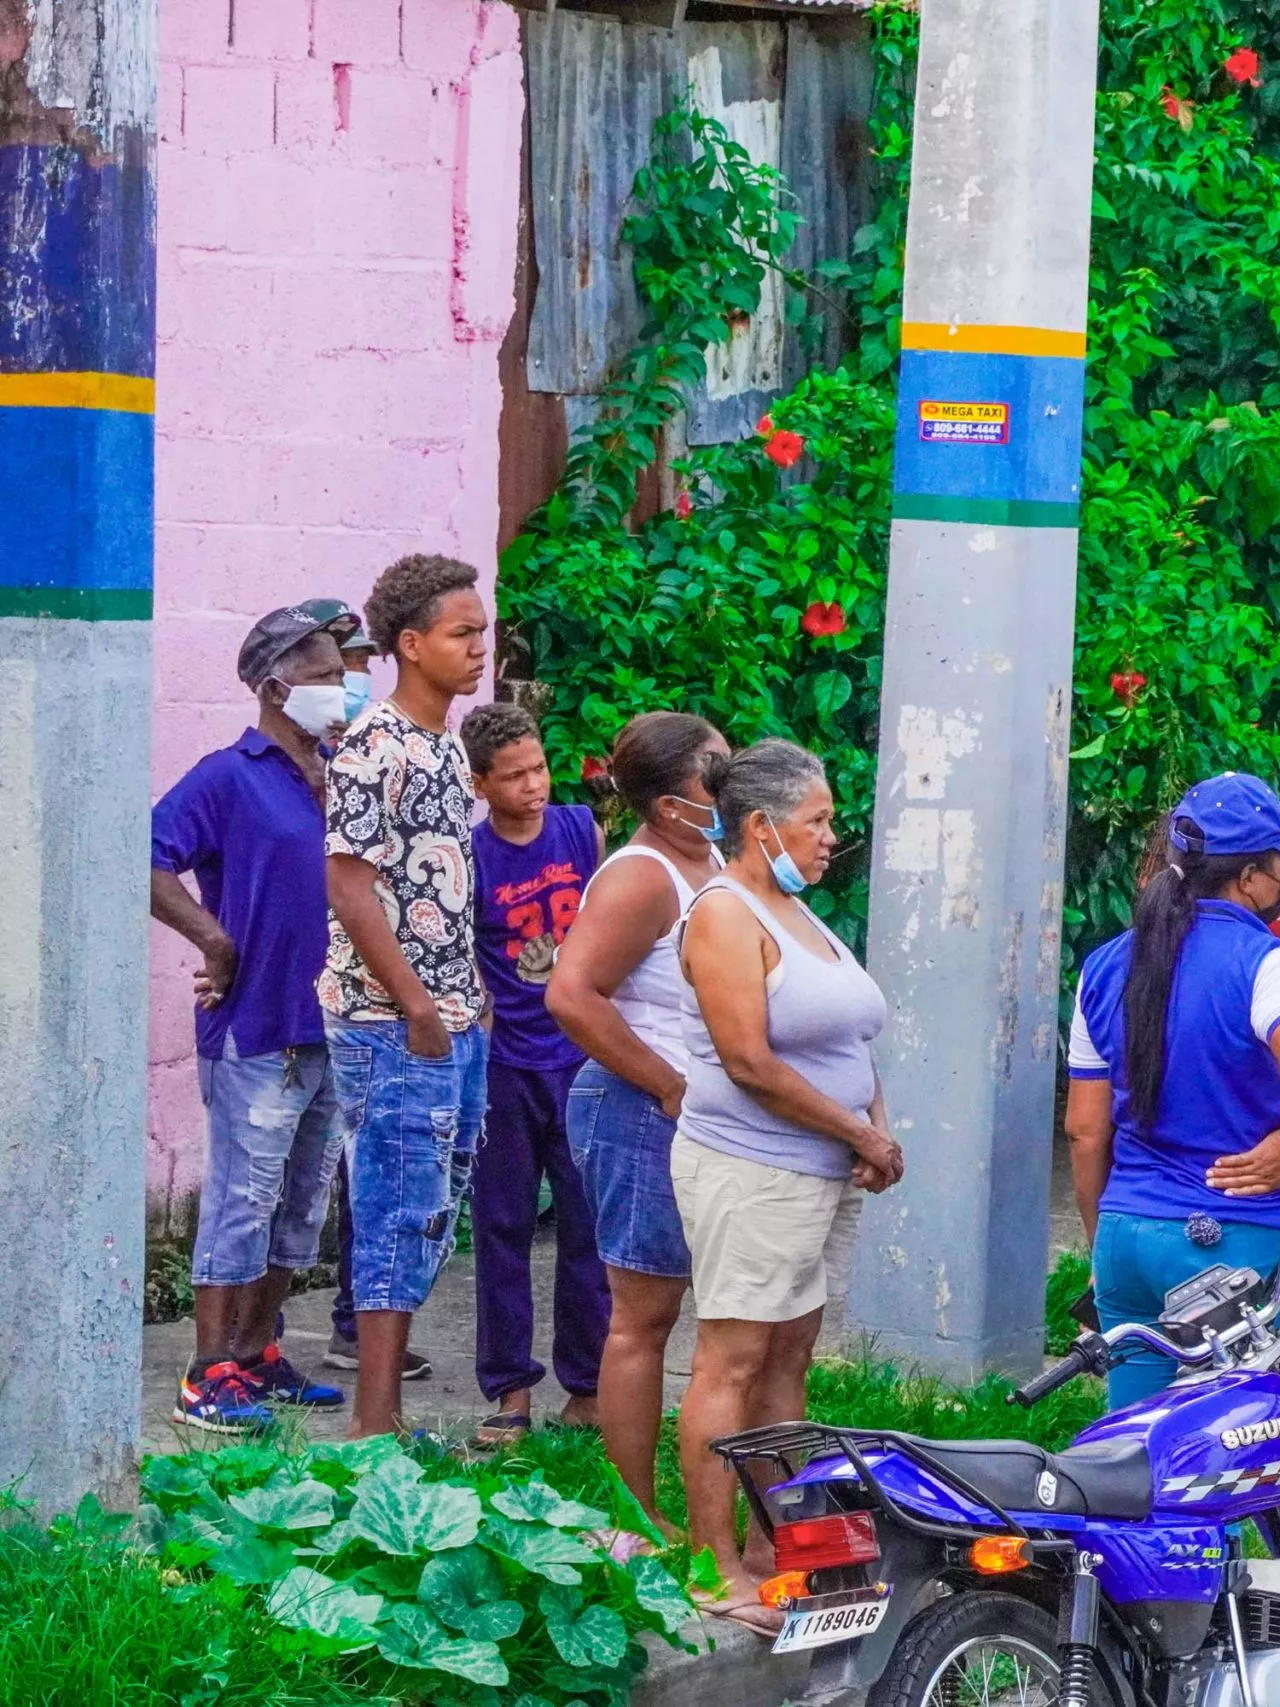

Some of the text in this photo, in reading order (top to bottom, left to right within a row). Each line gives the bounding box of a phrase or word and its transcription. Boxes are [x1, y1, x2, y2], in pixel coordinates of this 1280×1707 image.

[942, 406, 973, 417] MEGA
[977, 407, 1002, 418] TAXI
[1166, 1543, 1200, 1558] AX
[783, 1605, 880, 1641] K 1189046
